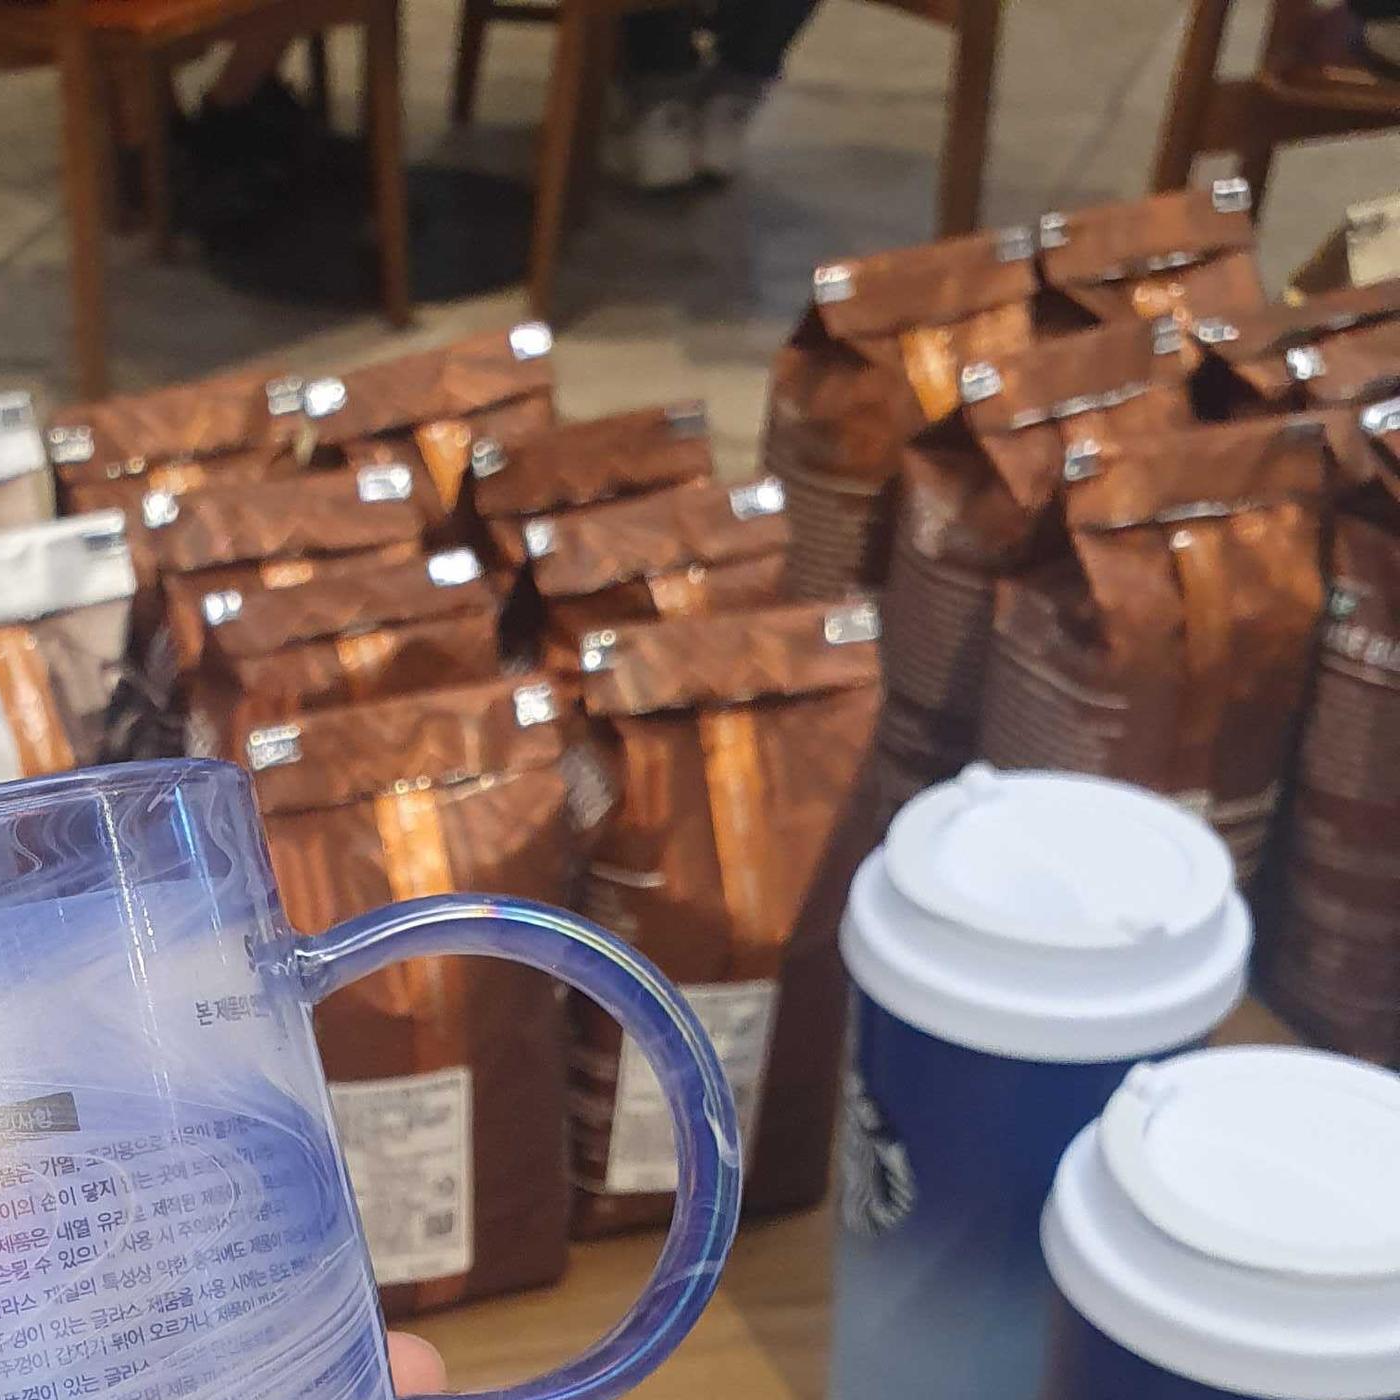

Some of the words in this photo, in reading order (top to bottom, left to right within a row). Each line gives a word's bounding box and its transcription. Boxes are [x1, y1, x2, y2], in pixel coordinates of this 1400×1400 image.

[194, 999, 213, 1026] 본
[40, 1155, 81, 1177] 가열,
[40, 1186, 77, 1212] 손이
[81, 1176, 117, 1203] 닿지
[56, 1216, 91, 1242] 내열
[34, 1256, 53, 1275] 수
[158, 1225, 176, 1245] 시
[102, 1263, 153, 1291] 특성상
[51, 1315, 87, 1339] 있는
[90, 1302, 145, 1330] 글라스
[199, 1278, 227, 1300] 사용
[63, 1373, 101, 1398] 있는
